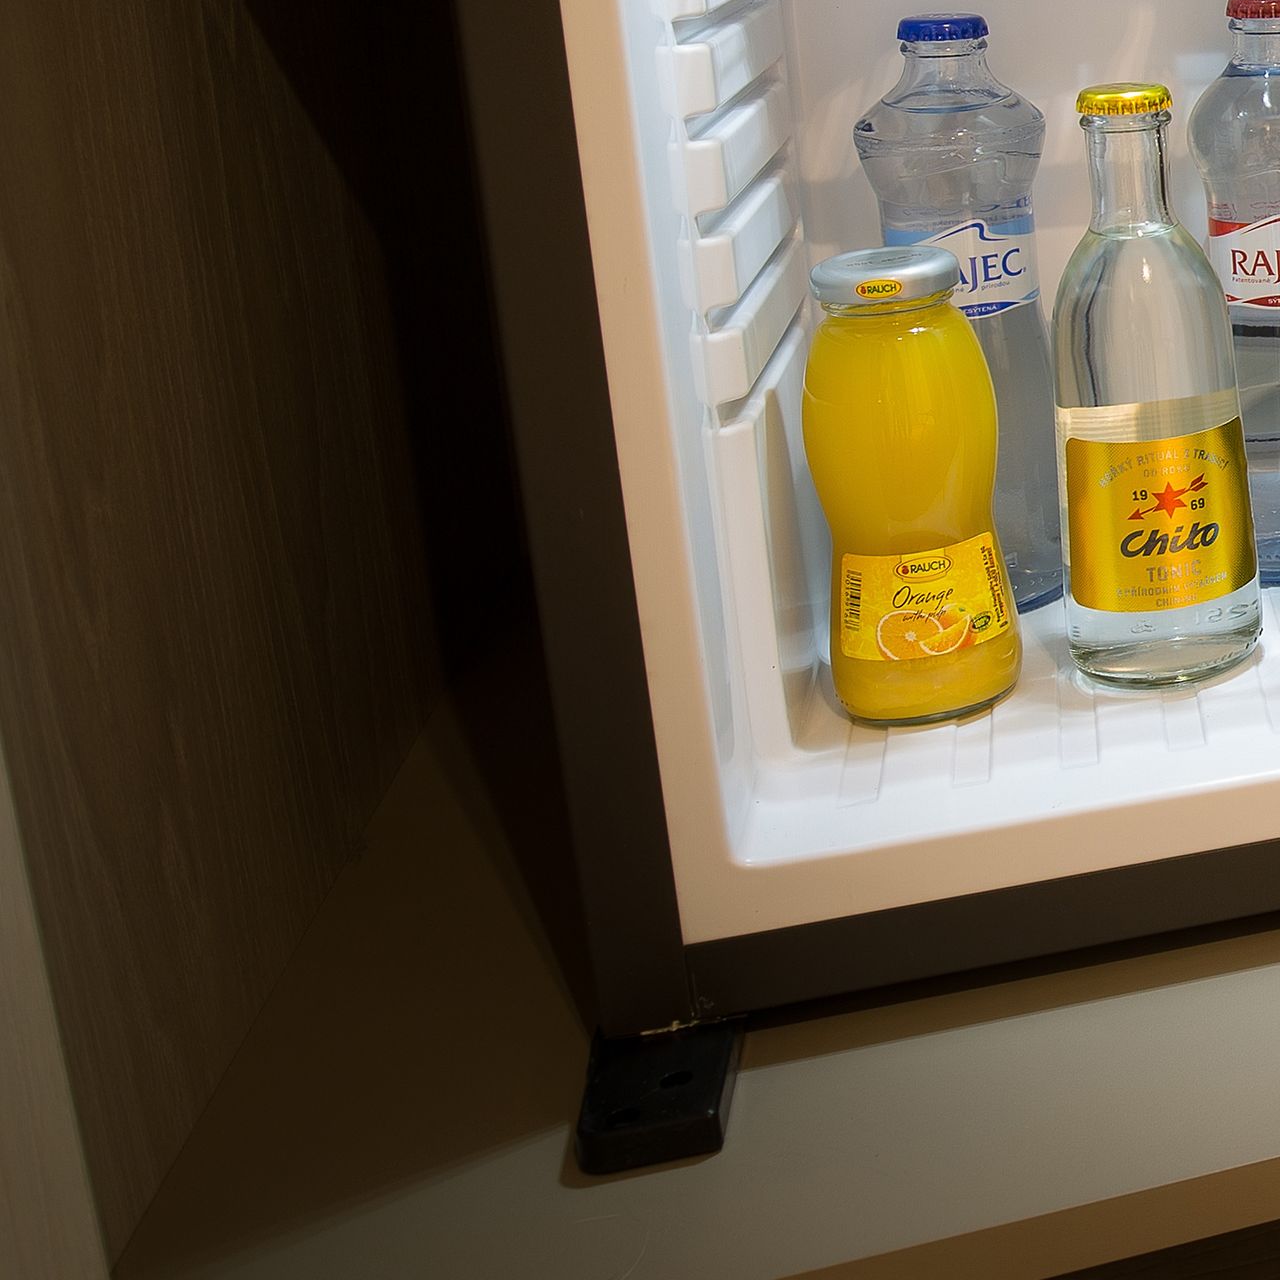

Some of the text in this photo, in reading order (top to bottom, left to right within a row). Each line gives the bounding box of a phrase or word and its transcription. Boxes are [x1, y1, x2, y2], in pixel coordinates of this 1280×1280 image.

[960, 247, 1024, 294] JEC
[867, 284, 897, 295] RAUCH
[965, 304, 998, 314] SÝTENÁ
[1132, 490, 1148, 502] 19
[1190, 498, 1205, 510] 69
[1120, 521, 1220, 558] Chito
[910, 560, 946, 574] RAUCH
[1146, 559, 1202, 582] TONIC
[892, 585, 954, 610] Orange
